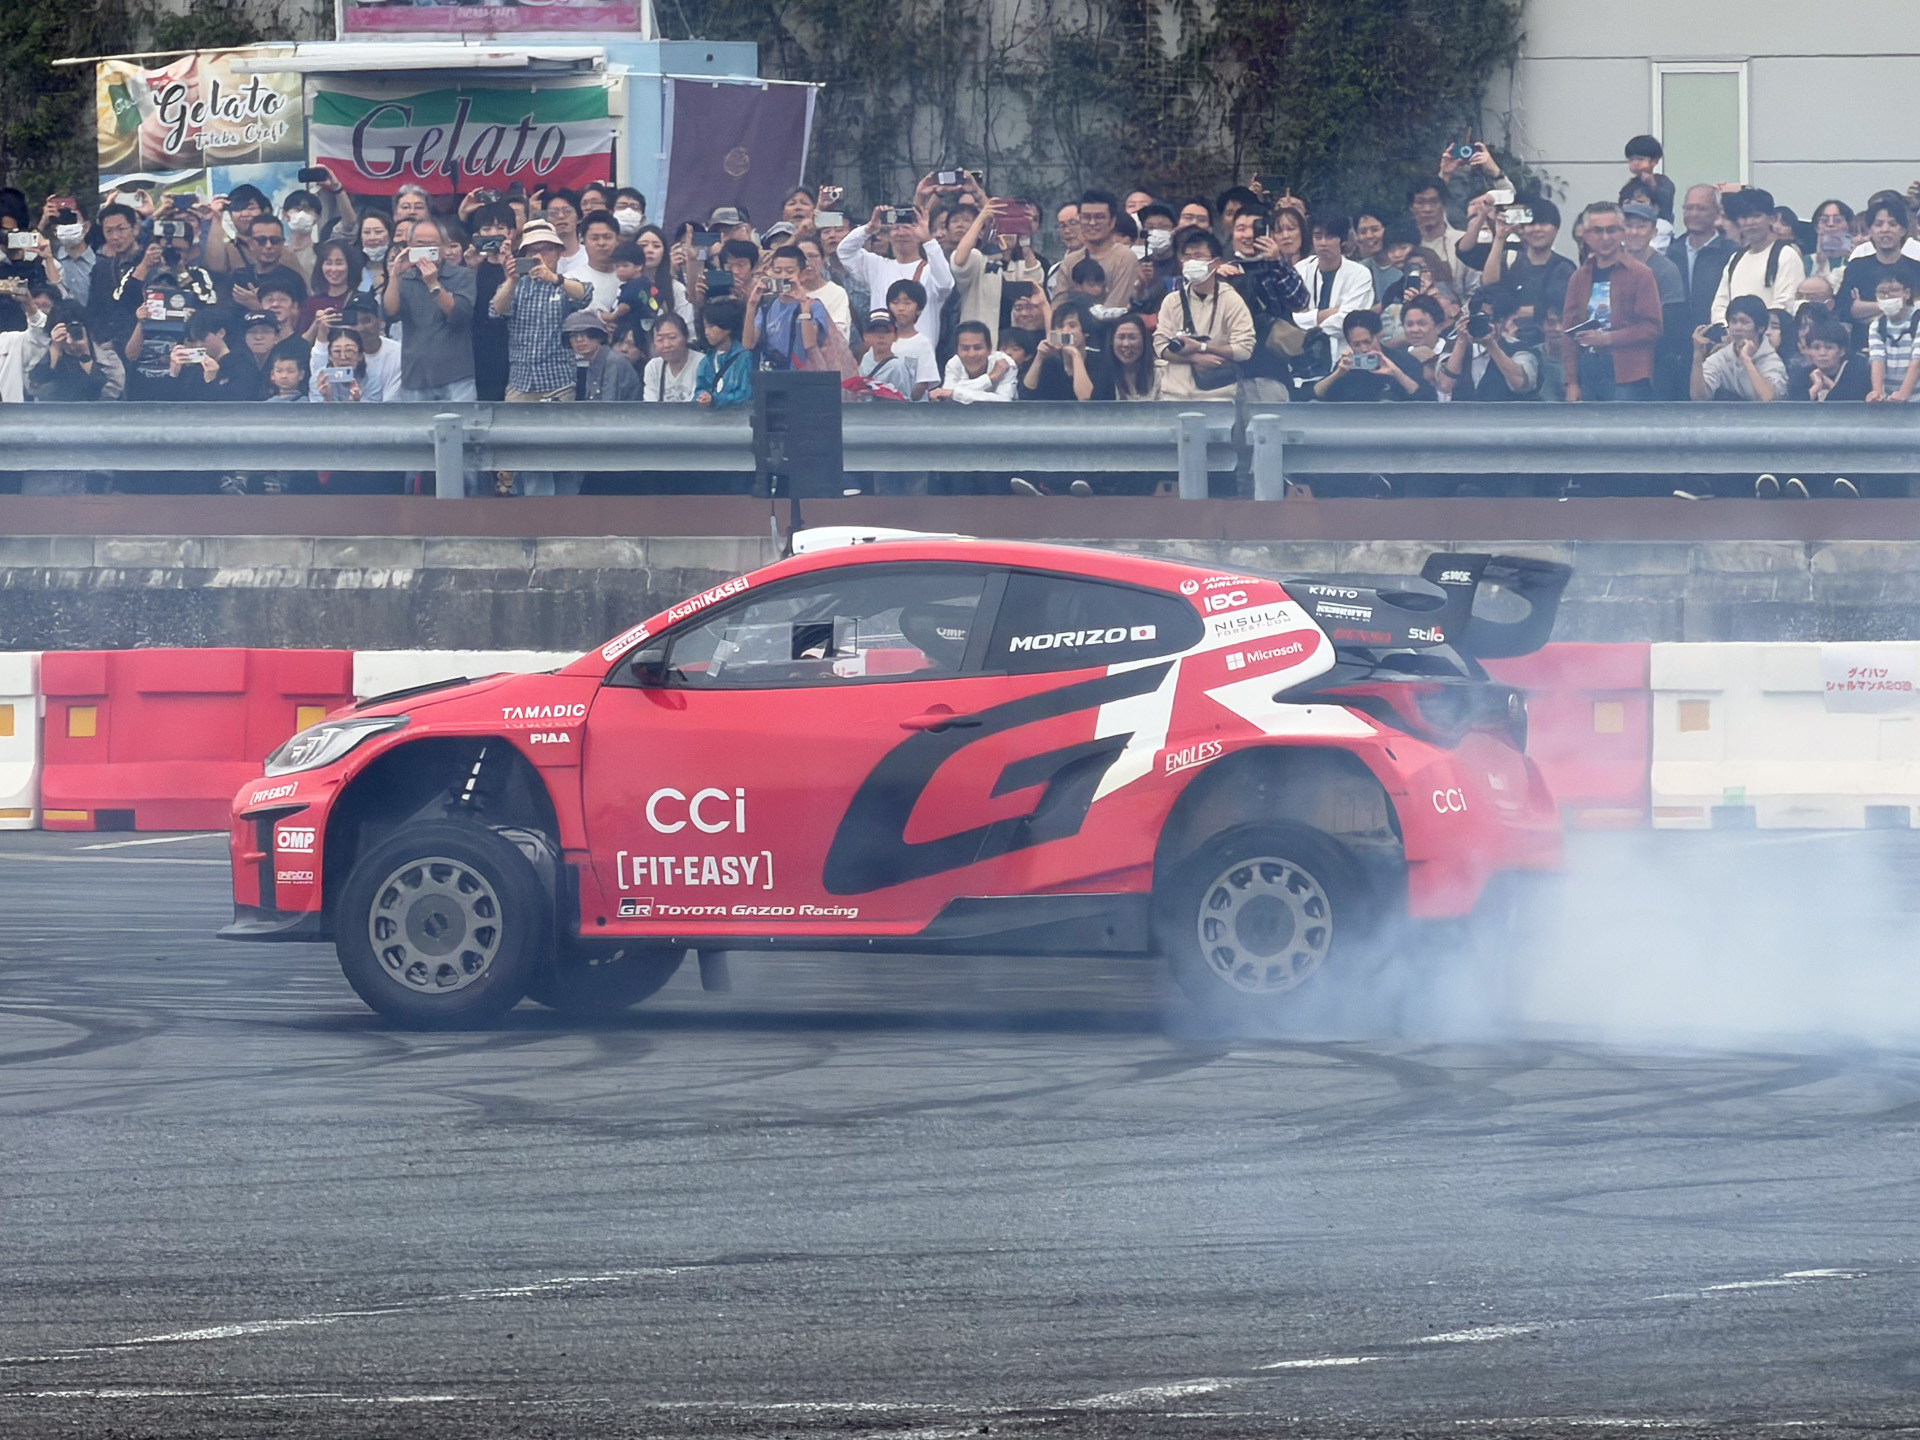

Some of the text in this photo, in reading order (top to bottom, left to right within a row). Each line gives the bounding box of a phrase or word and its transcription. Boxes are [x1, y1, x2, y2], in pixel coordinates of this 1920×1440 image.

[153, 76, 284, 152] Gelato
[352, 96, 566, 179] Gelato
[1309, 585, 1358, 599] KINTO
[1214, 610, 1289, 632] NISULA
[1009, 628, 1127, 652] MORIZO
[1246, 642, 1304, 663] Microsoft
[501, 704, 586, 720] TAMADIC
[530, 732, 571, 744] PIAA
[1165, 740, 1223, 773] ENDLESS
[277, 830, 315, 849] OMP
[618, 903, 859, 919] GR TOYOTA GAZOO Racing
